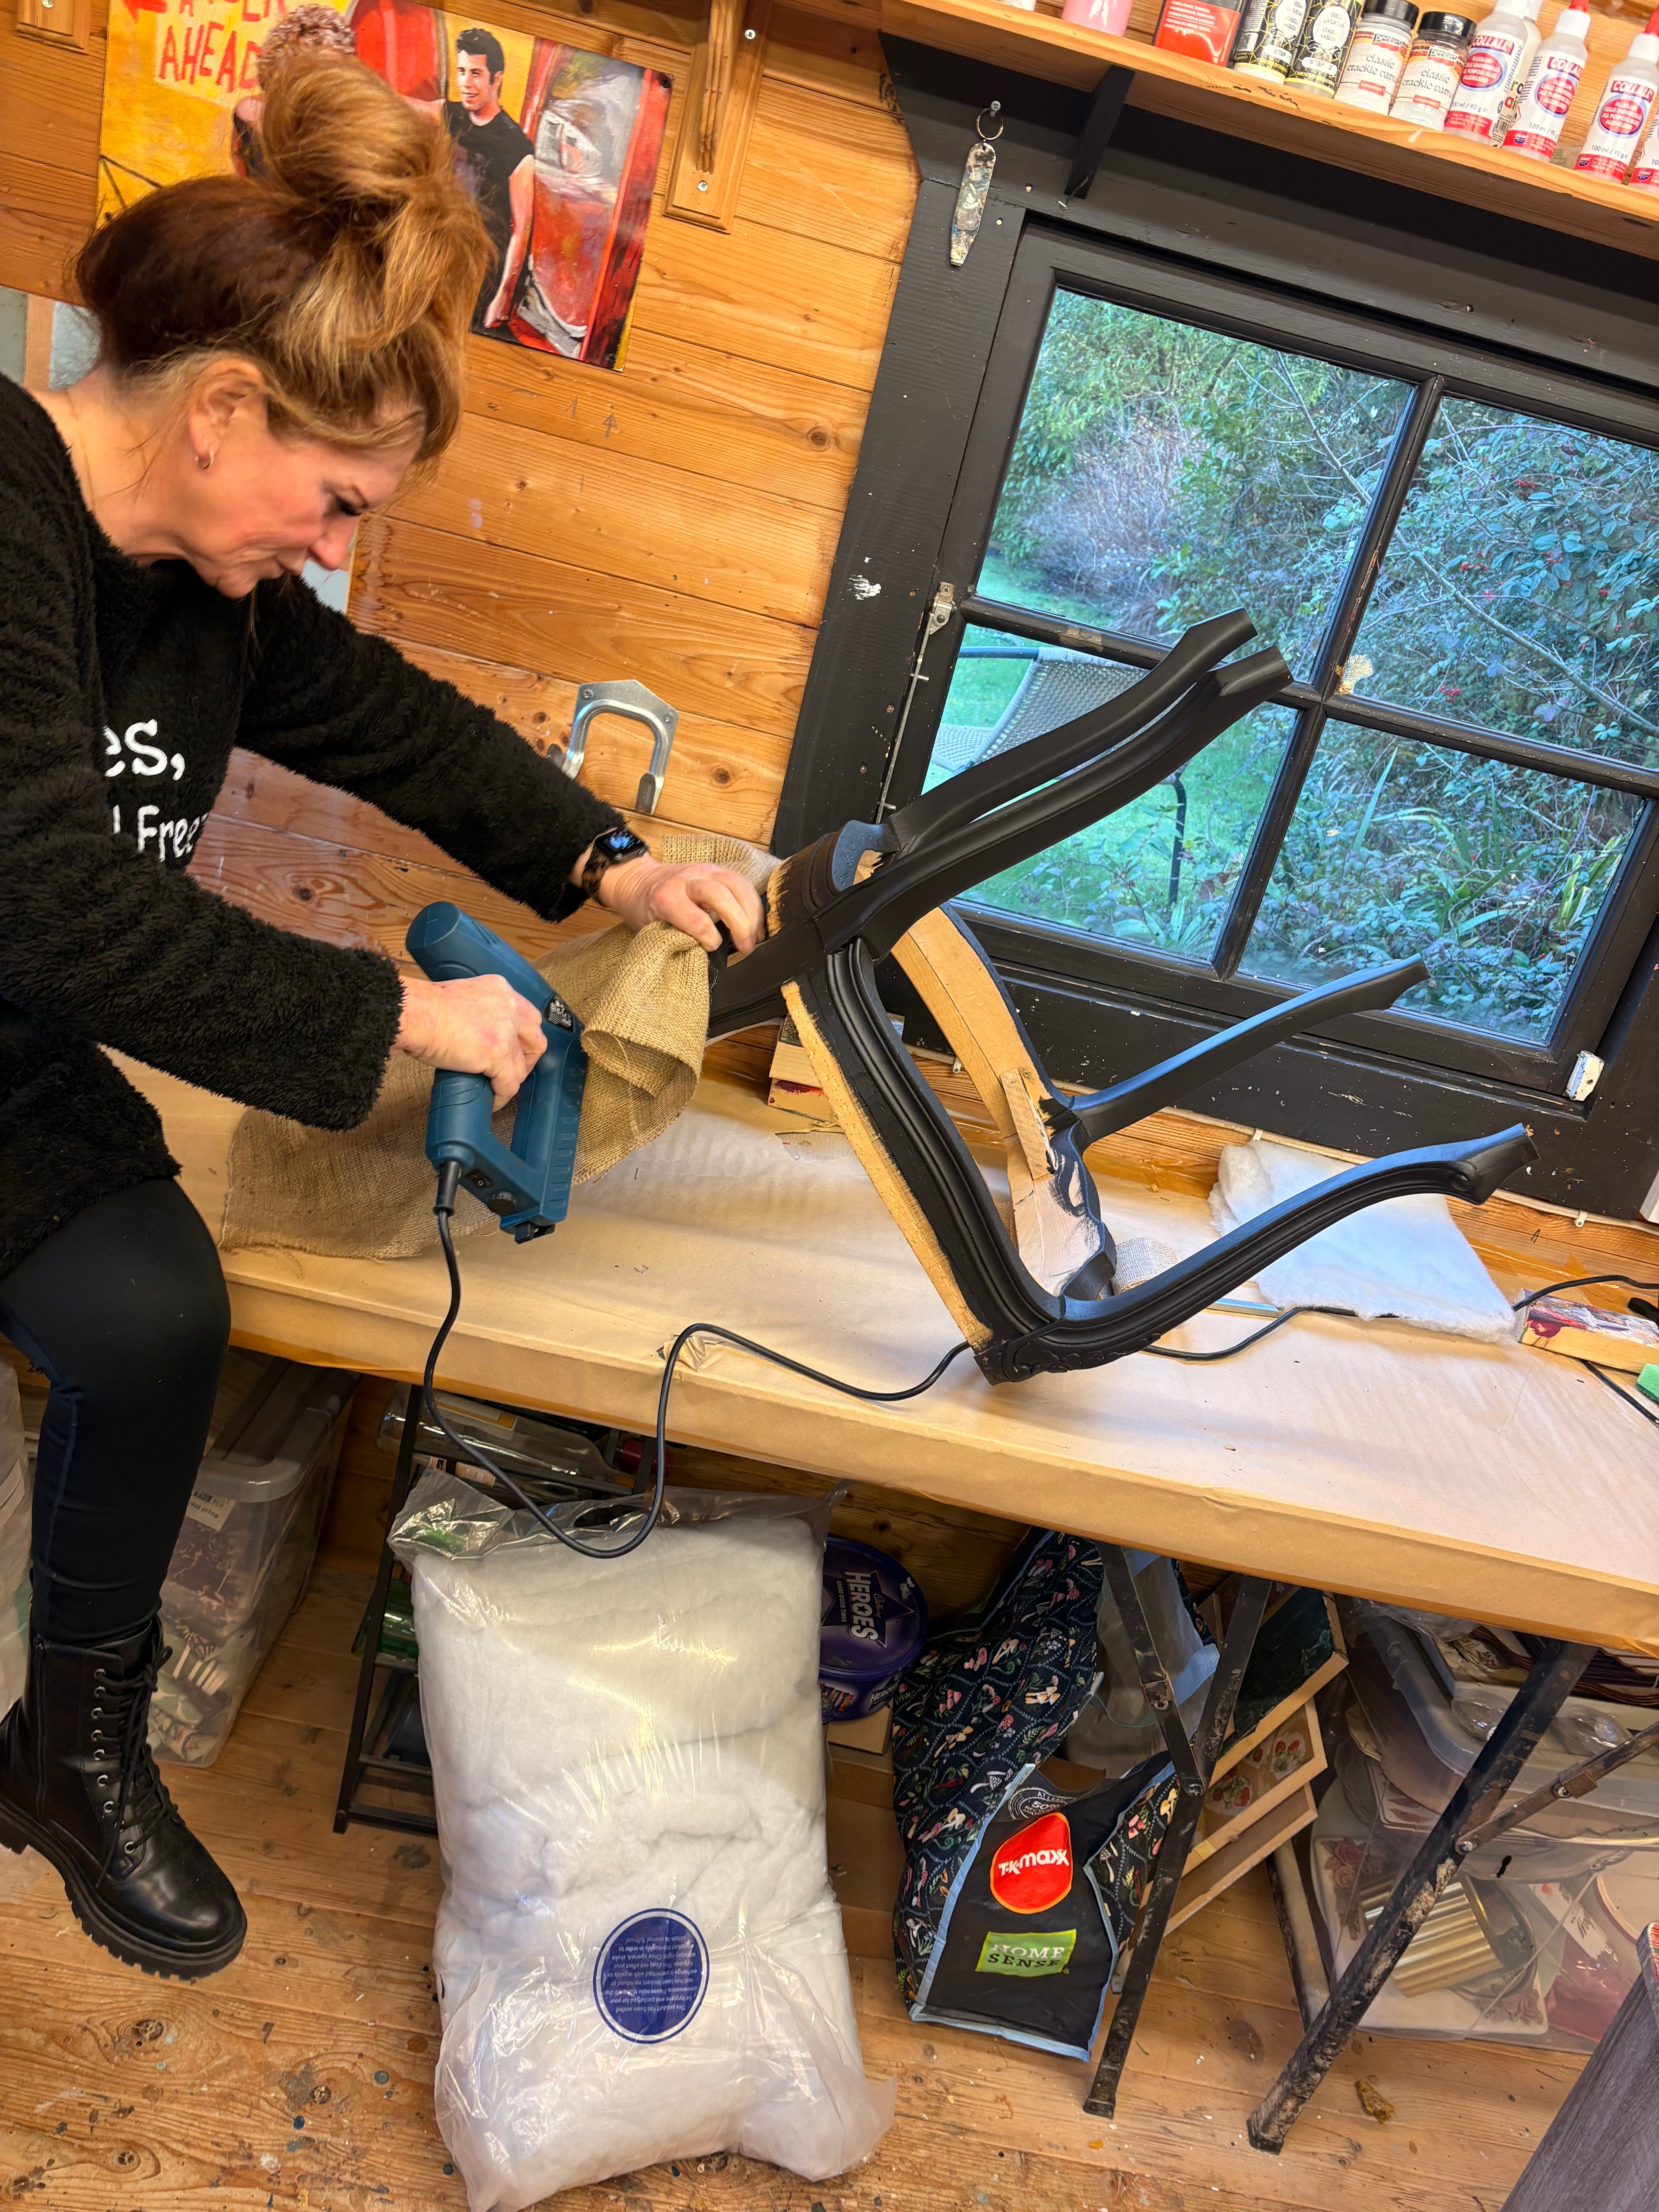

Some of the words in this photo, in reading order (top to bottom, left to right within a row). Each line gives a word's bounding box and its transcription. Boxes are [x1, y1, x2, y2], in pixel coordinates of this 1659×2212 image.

[158, 21, 263, 92] AHEAD
[137, 804, 210, 863] Free
[844, 1571, 878, 1640] HEROES
[988, 1953, 1061, 1968] SENSE
[991, 1944, 1065, 1958] HOME
[657, 2004, 675, 2012] product
